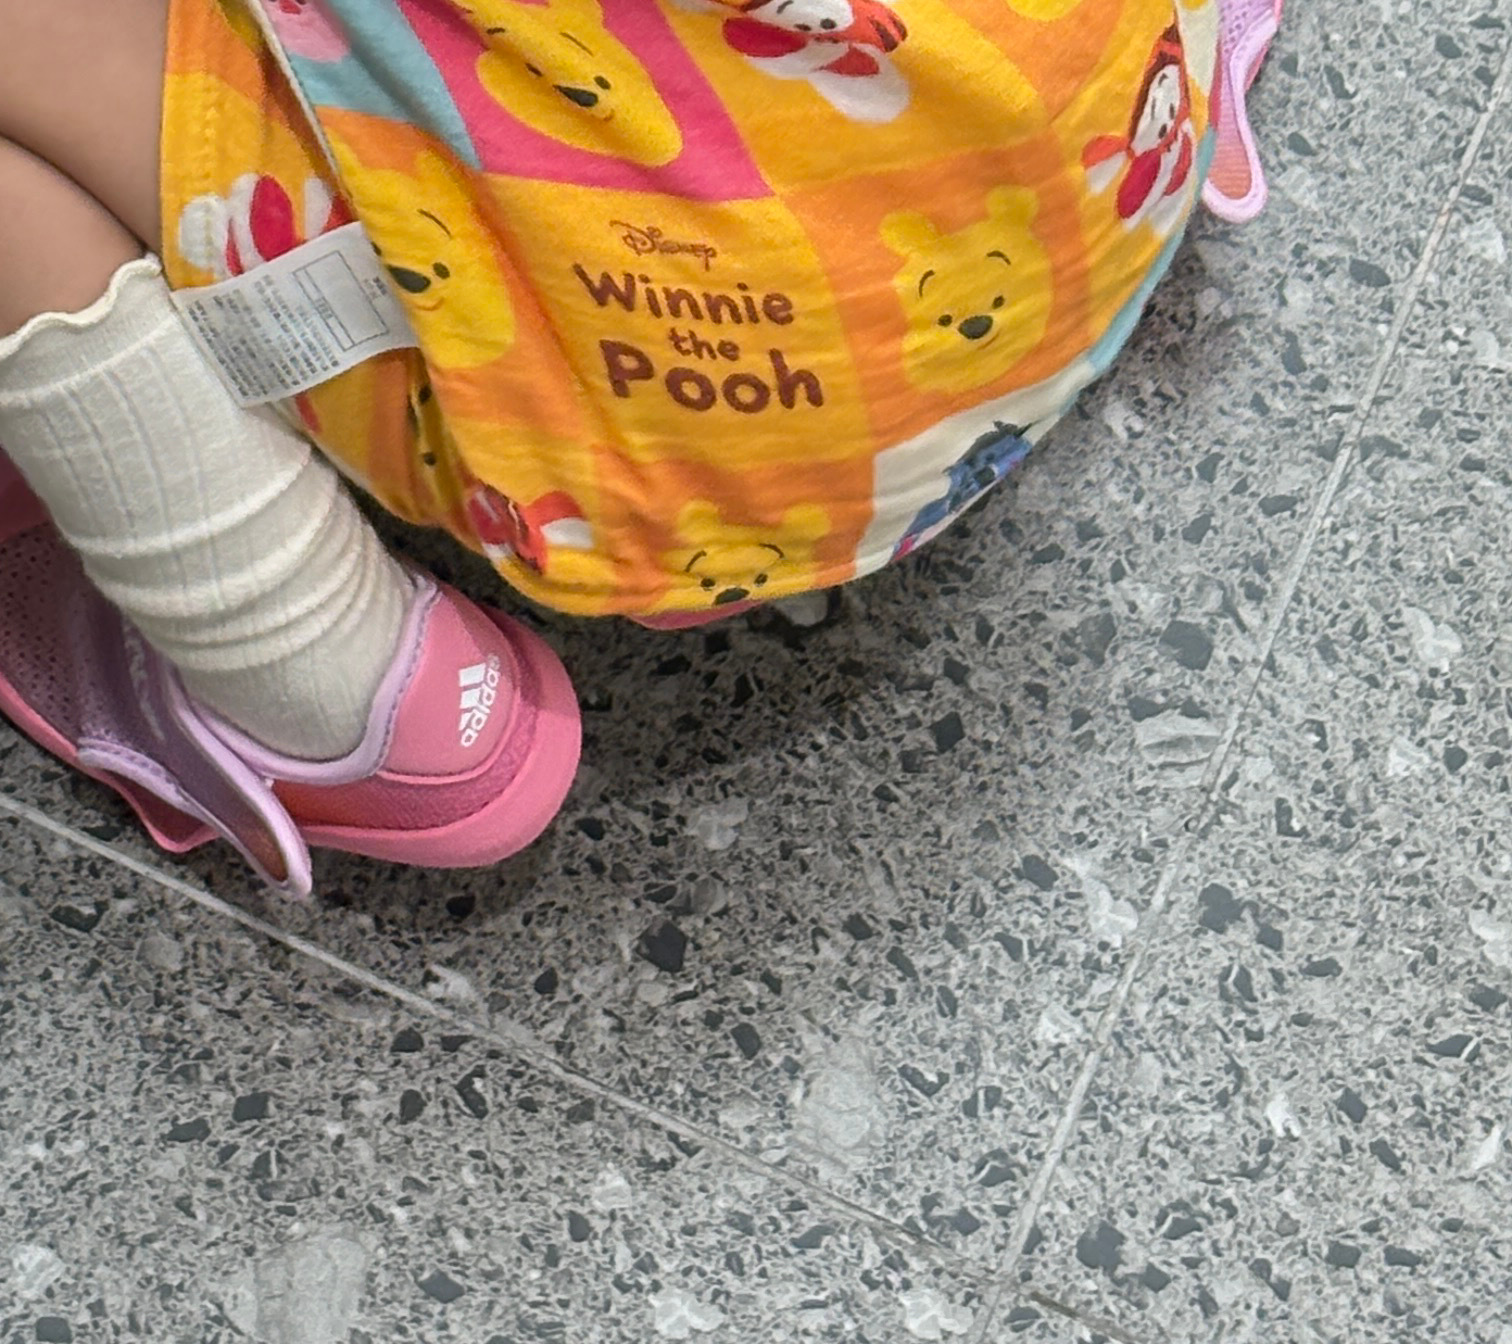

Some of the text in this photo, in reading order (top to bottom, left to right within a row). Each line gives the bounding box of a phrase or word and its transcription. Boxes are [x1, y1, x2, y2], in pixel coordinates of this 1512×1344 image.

[609, 219, 717, 272] Disney
[574, 263, 795, 326] Winnie
[668, 327, 741, 363] the
[598, 339, 826, 414] Pooh
